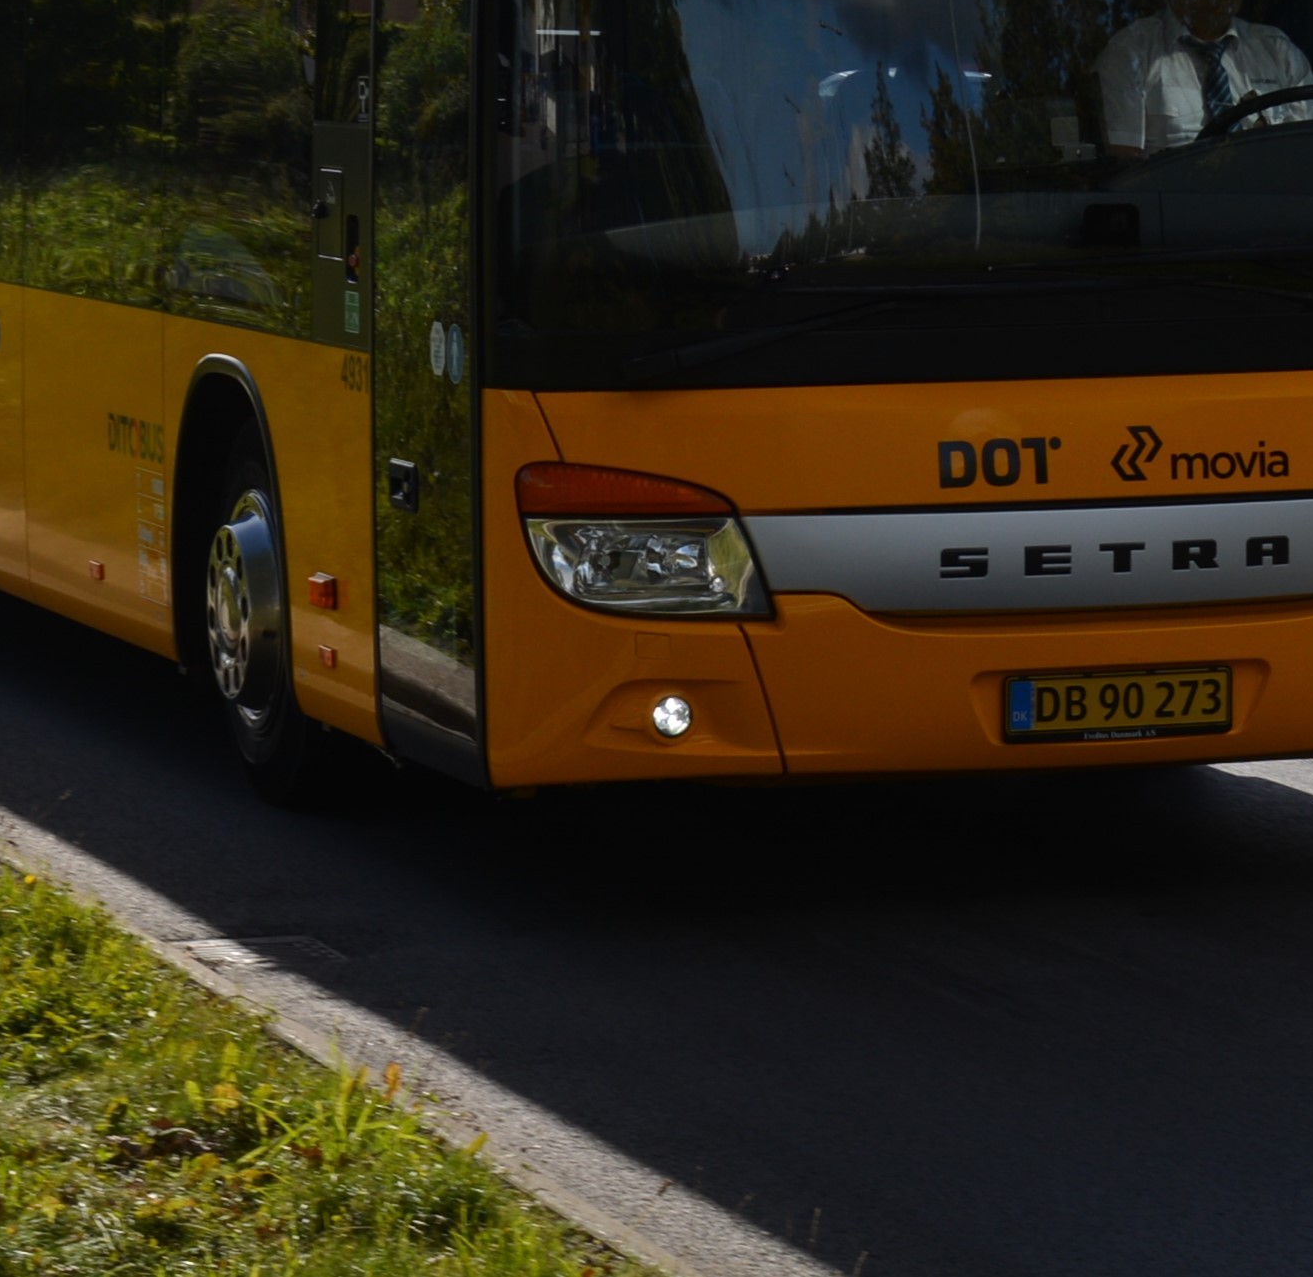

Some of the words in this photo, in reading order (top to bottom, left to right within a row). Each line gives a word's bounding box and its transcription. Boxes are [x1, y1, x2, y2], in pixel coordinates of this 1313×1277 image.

[938, 436, 1060, 489] DOT
[1170, 441, 1291, 480] movia
[939, 535, 1290, 579] SETRA
[1013, 710, 1028, 722] DK
[1037, 685, 1087, 723] DB
[1099, 682, 1144, 722] 90
[1154, 678, 1222, 719] 273
